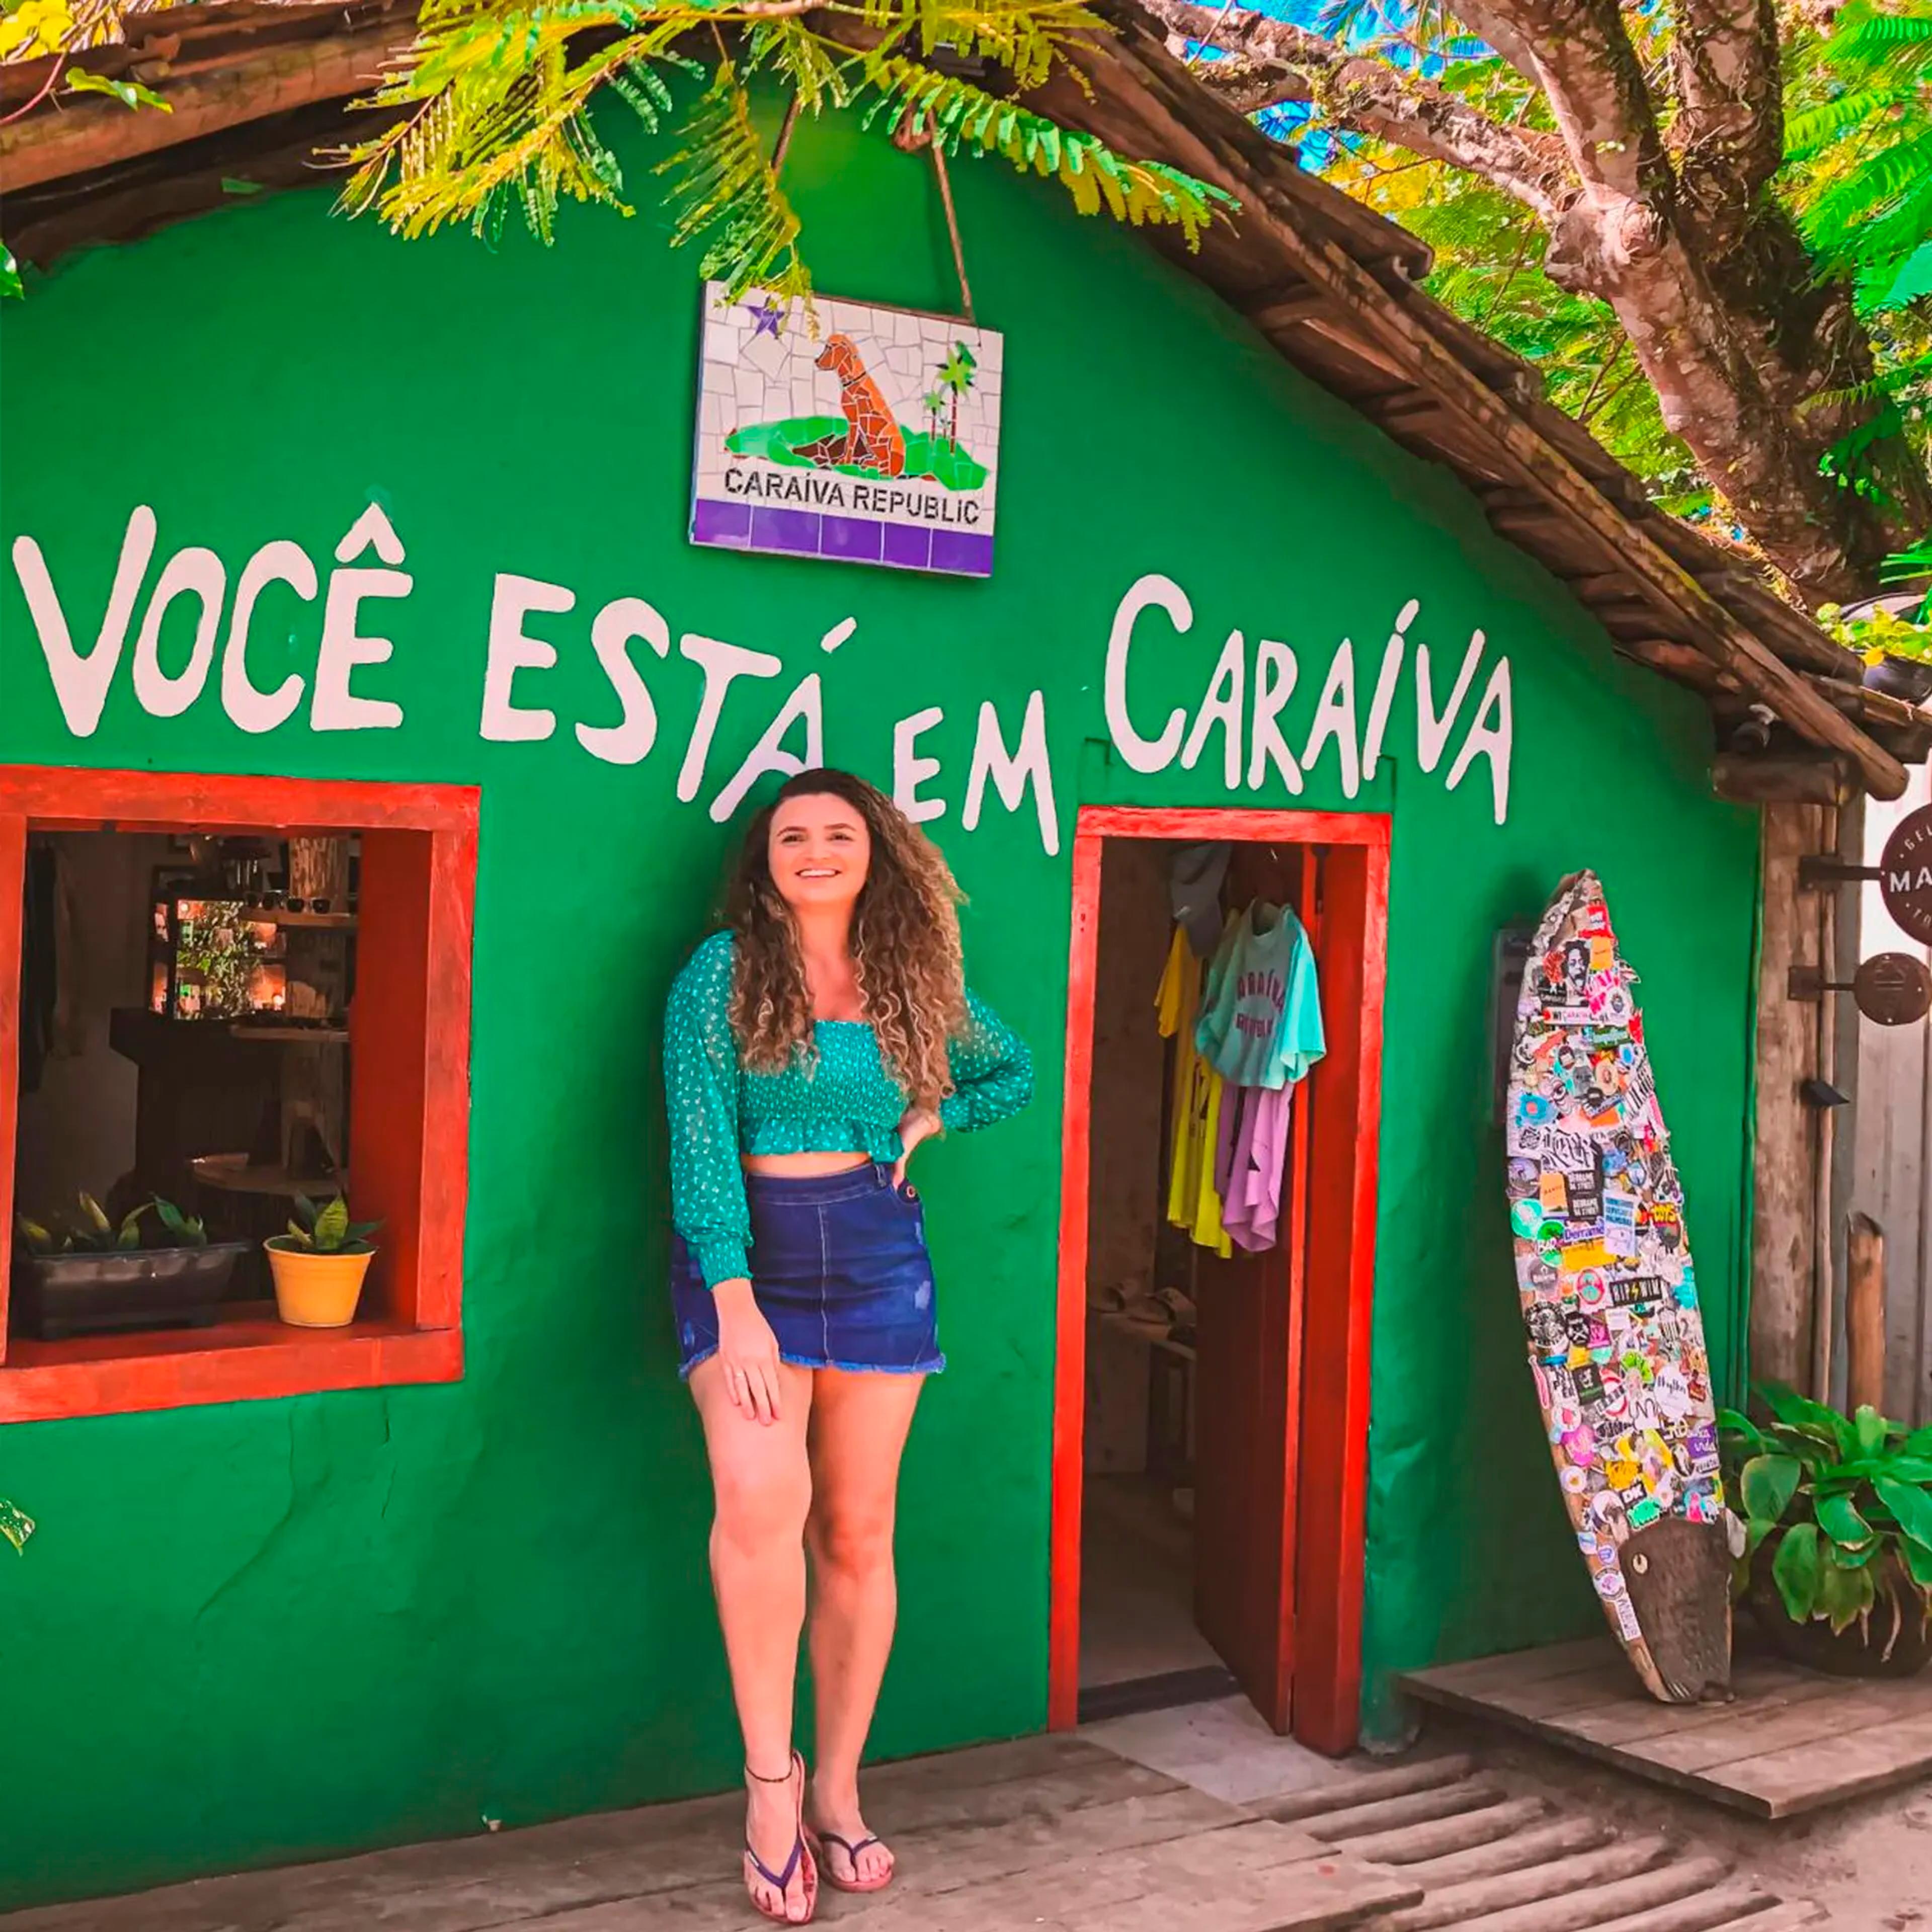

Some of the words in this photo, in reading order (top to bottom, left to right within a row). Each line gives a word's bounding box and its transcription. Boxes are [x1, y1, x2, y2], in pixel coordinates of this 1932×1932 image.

[724, 468, 845, 507] CARAÍVA
[853, 485, 980, 525] REPUBLIC
[12, 502, 414, 738] VOCÊ
[479, 573, 857, 823] ESTÁ
[893, 690, 1060, 856] EM
[1104, 574, 1512, 825] CARAÍVA
